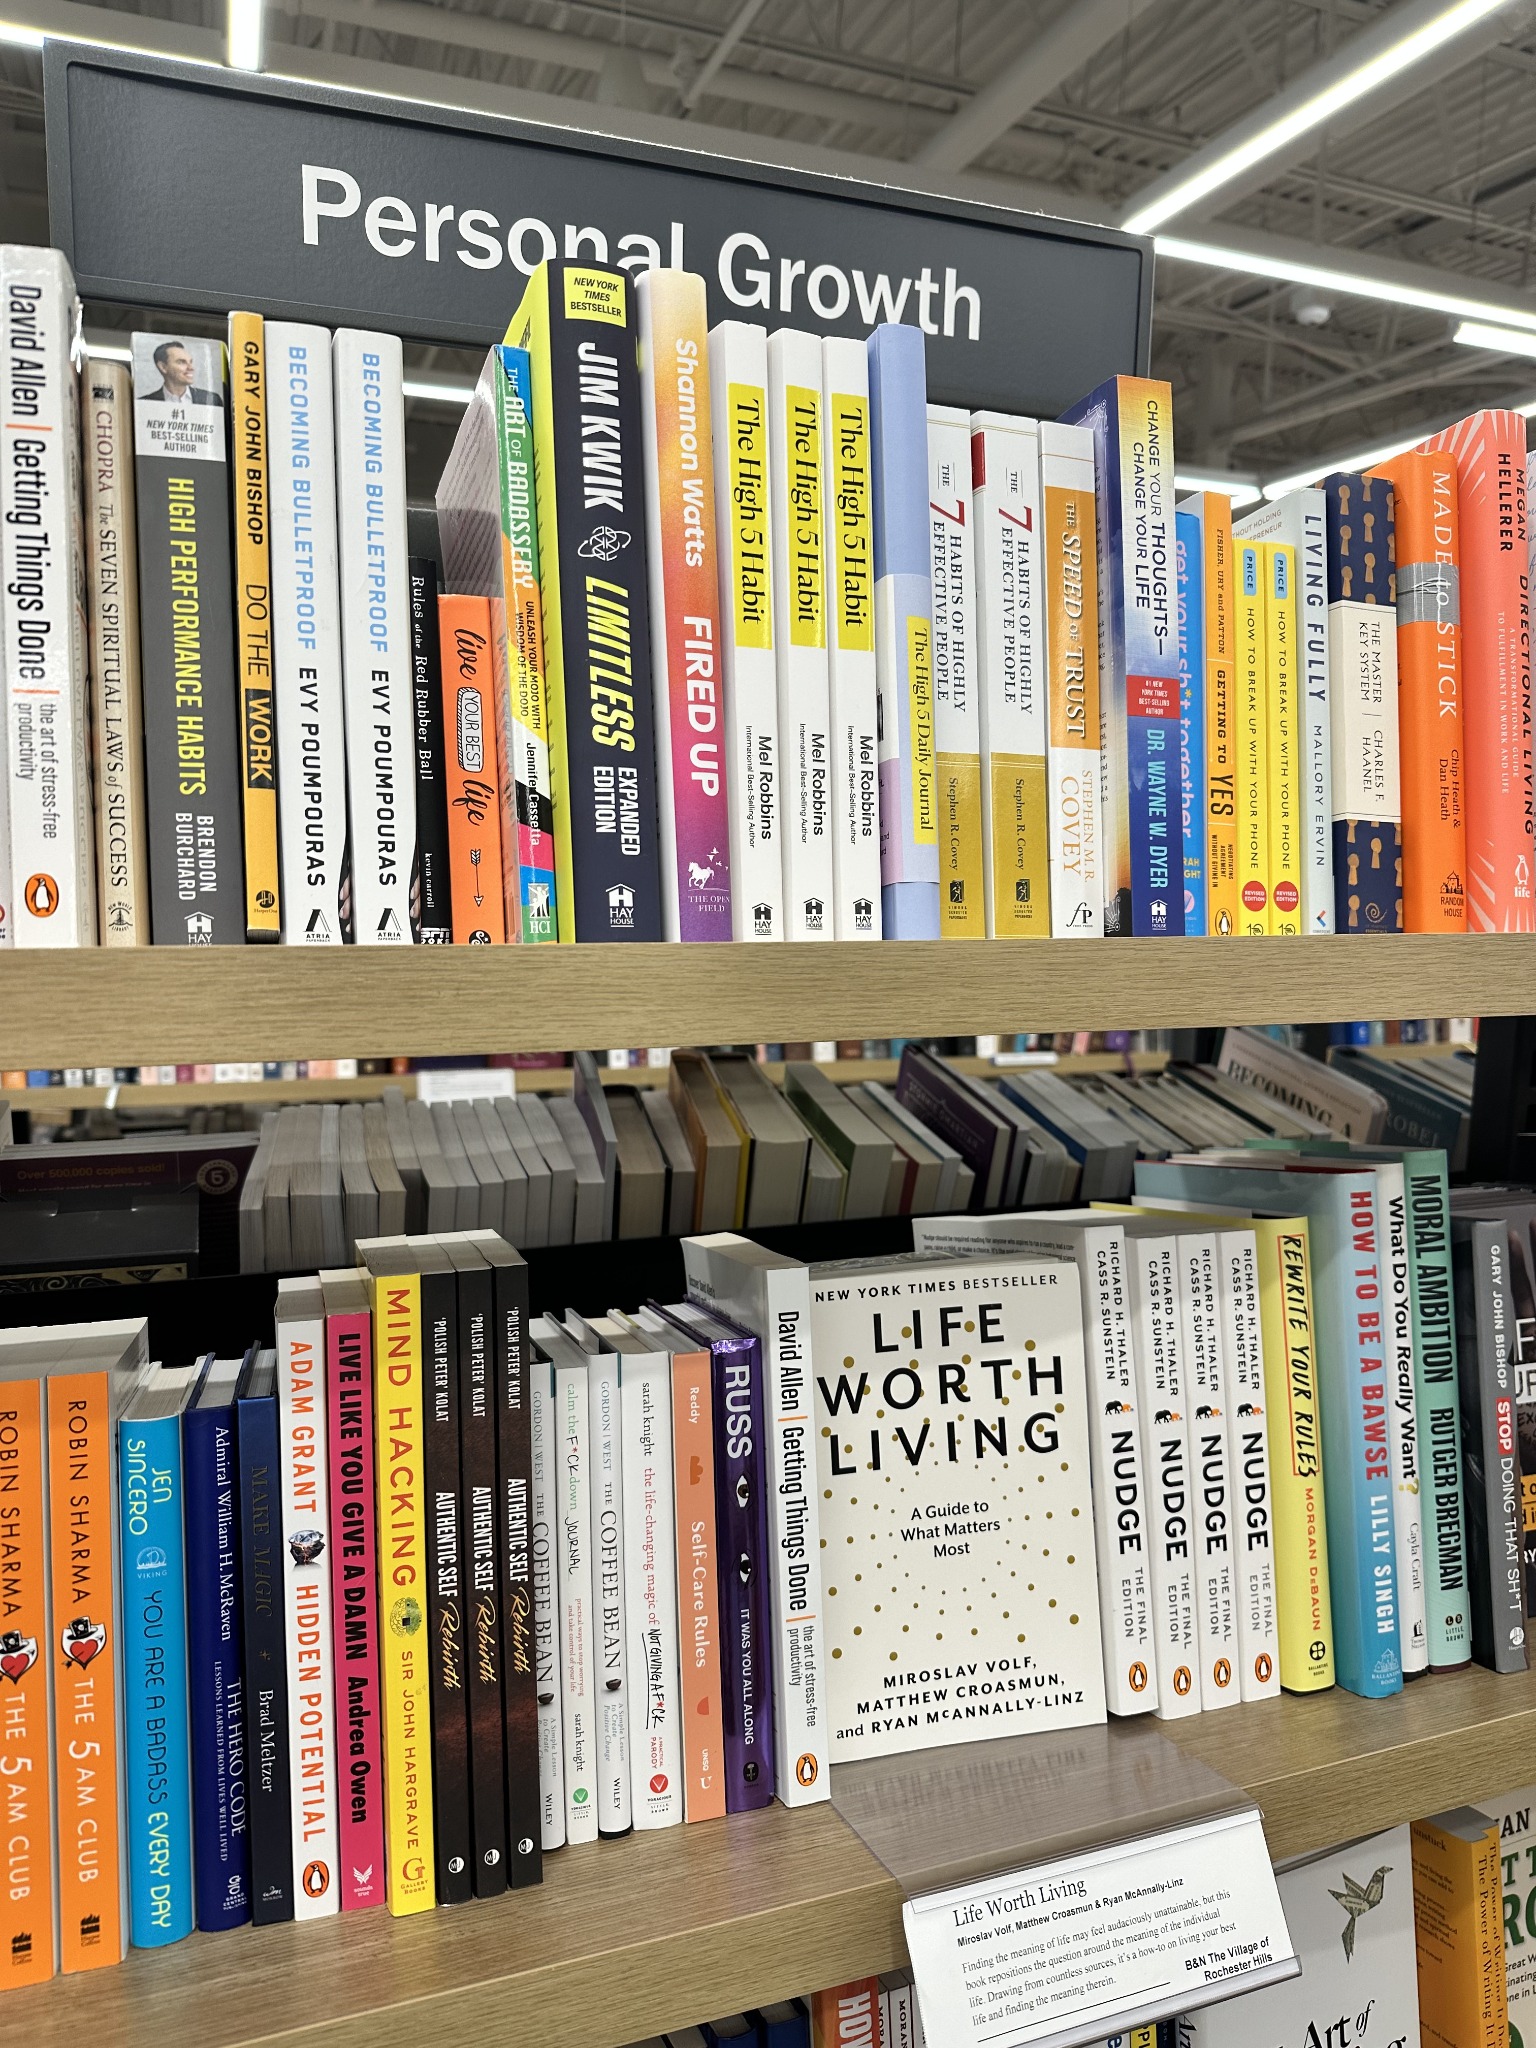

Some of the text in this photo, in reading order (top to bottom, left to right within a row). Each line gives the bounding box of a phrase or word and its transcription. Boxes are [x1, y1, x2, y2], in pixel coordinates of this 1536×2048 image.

[302, 164, 981, 340] Personal Growth
[573, 277, 619, 292] NEW YORK
[570, 301, 622, 317] BESTSELLER
[584, 290, 610, 302] TIMES
[146, 421, 214, 433] NEW YORK TIMES
[151, 430, 209, 444] BEST-SELLING
[164, 443, 197, 454] AUTHOR
[171, 409, 186, 420] #1
[675, 338, 706, 567] Shannon Watts
[6, 285, 52, 679] David Allen Getting Things Done
[733, 398, 766, 625] The High 5 Habit
[1498, 453, 1513, 552] HELLERER
[1515, 468, 1527, 541] MEGAN
[243, 341, 274, 781] GARY JOHN BISHOP DO THE WORK
[578, 342, 634, 752] JIM KWIK LIMITLESS
[1133, 442, 1150, 609] CHANGE YOUR LIFE
[168, 477, 207, 796] HIGH PERFORMANCE HABITS
[288, 345, 326, 887] BECOMING BULLETPROOF EVY POUMPOURAS
[1304, 515, 1326, 702] LIVING FULLY
[96, 411, 128, 887] CHOPRA The SEVEN SPIRITUAL LAWS of SUCCESS
[14, 703, 37, 780] productivity
[40, 704, 60, 838] the art of stress-free
[1210, 669, 1233, 816] GETTING TO YES
[758, 735, 775, 840] Mel Robbins
[1313, 725, 1325, 866] MALLORY ERVIN
[1439, 758, 1451, 821] Dan Heath
[1451, 749, 1461, 829] Chip Heath &
[815, 1274, 1058, 1302] NEW YORK TIMES BESTSELLER
[873, 1303, 1005, 1353] LIFE
[640, 1382, 652, 1456] sarah knight
[725, 1364, 753, 1459] RUSS
[816, 1355, 1064, 1417] WORTH
[1350, 1191, 1394, 1634] HOW TO BE A BAWSE LILLY SINGH
[1410, 1175, 1464, 1591] MORAL AMBITION RUTGER BREGMAN
[829, 1412, 1059, 1476] LIVING
[127, 1438, 147, 1536] SINCERO
[152, 1467, 172, 1504] JEN
[911, 1501, 989, 1521] A Guide to
[900, 1520, 1001, 1542] What Matters
[933, 1542, 971, 1558] Most
[1111, 1430, 1147, 1645] NUDGE THE FINAL
[137, 1569, 167, 1579] VIKING
[290, 1341, 326, 1843] ADAM GRANT HIDDEN POTENTIAL
[1122, 1579, 1134, 1638] EDITION
[68, 1400, 100, 1883] ROBIN SHARMA THE 5 AM CLUB
[883, 1656, 1038, 1689] MIROSLAV VOLF,
[259, 1689, 274, 1793] Brad Meltzer
[953, 1880, 1087, 1927] Life Worth Living
[957, 1877, 1184, 1947] Miroslav Volf, Matthew Croasmun & Ryan McAnnally-Linz
[961, 1889, 1231, 1974] Finding the meaning of life may feel audaciously unattainable, but this
[1185, 1936, 1269, 1970] B&N The Village of
[1204, 1953, 1273, 1981] Rochester Hills
[1356, 2000, 1375, 2038] of
